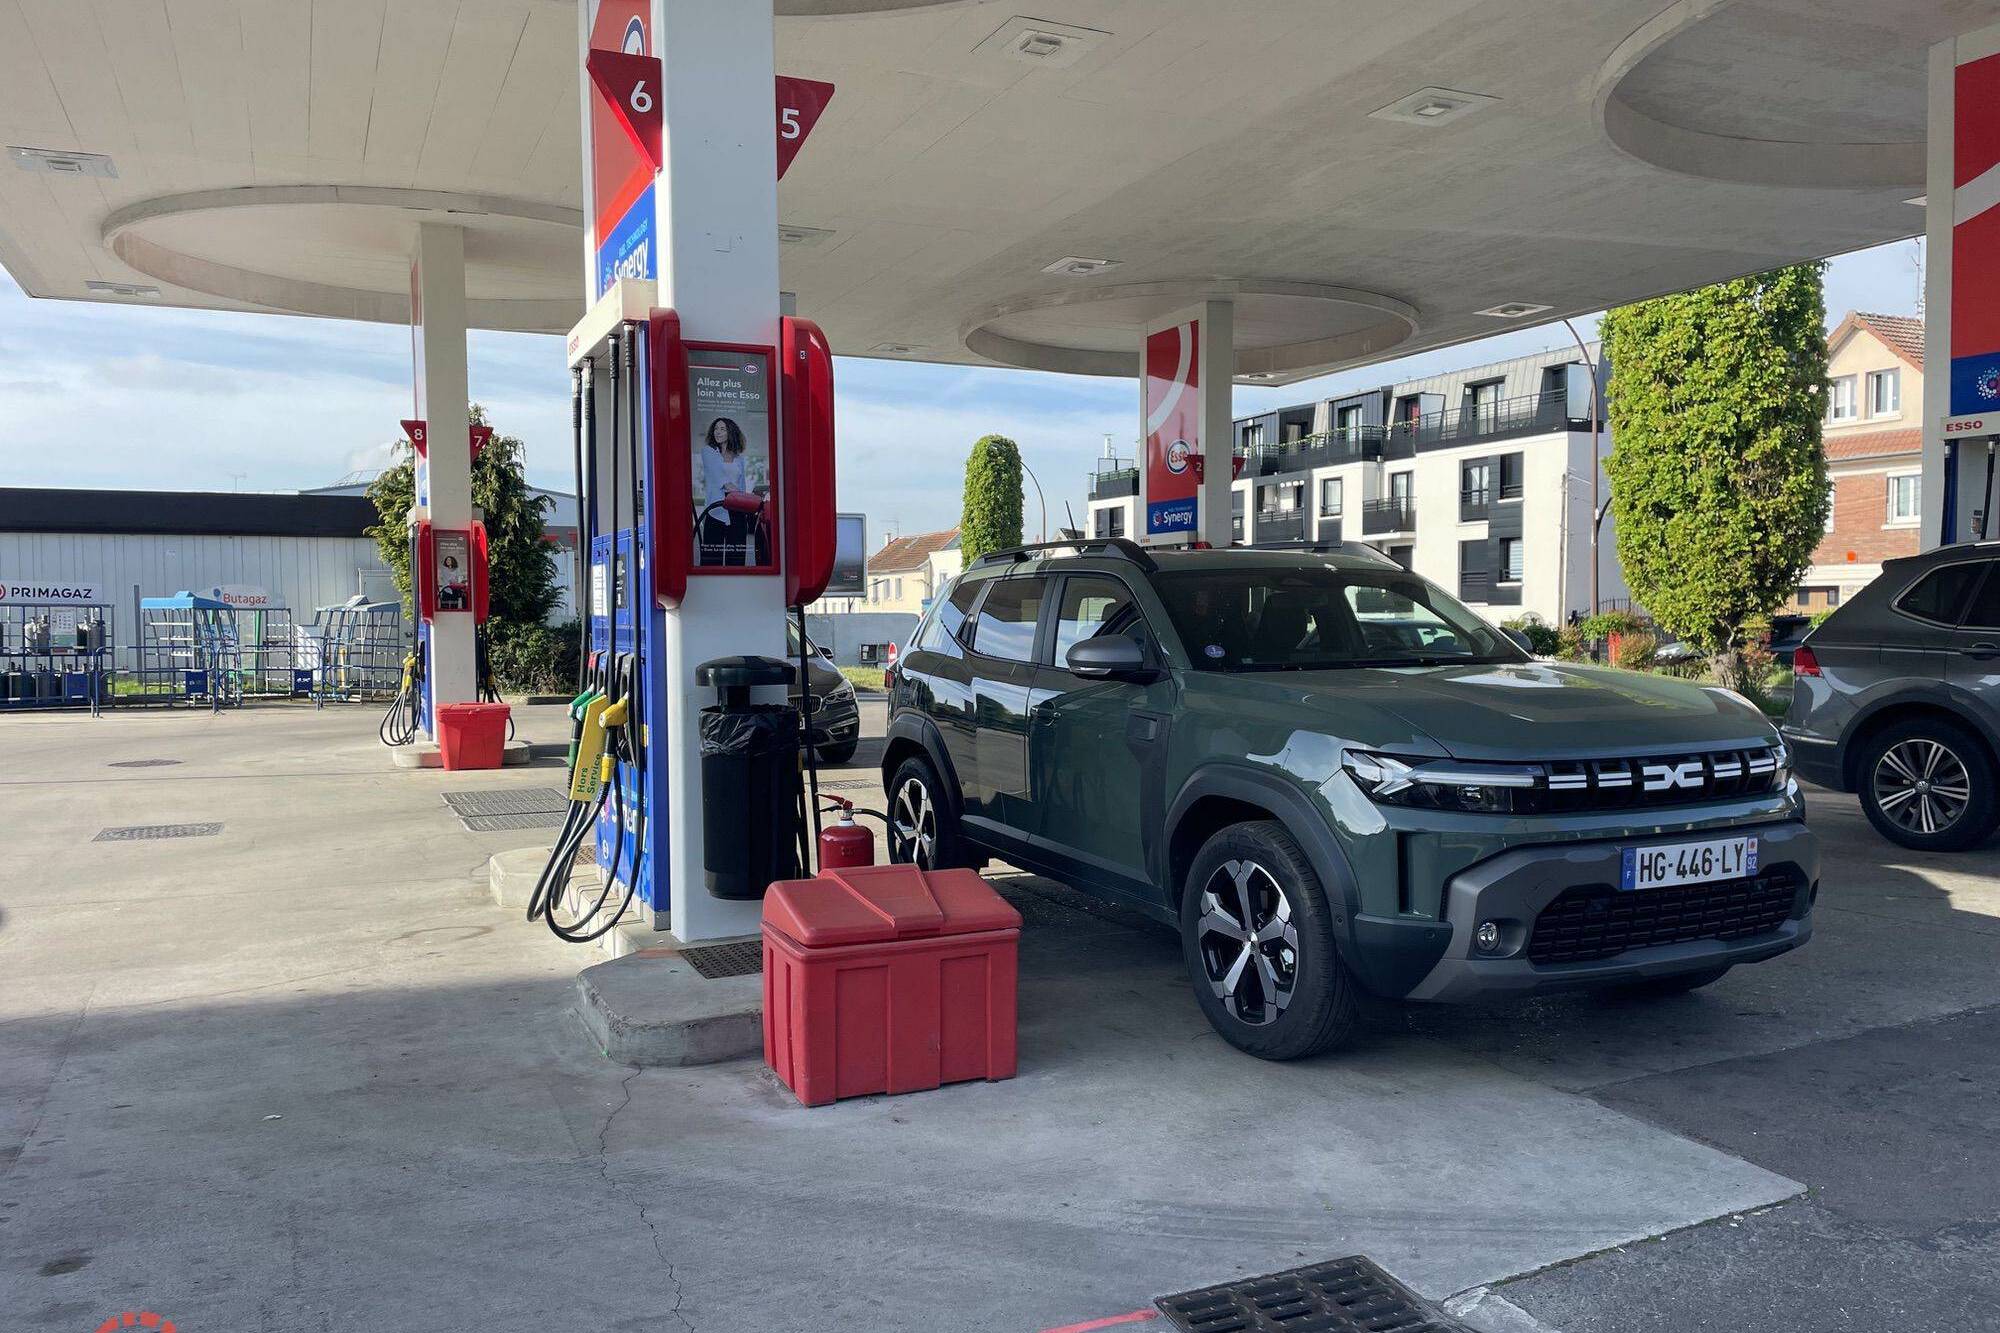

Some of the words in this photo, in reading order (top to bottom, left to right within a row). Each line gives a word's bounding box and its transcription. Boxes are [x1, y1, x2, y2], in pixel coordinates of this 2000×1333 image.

[630, 80, 652, 113] 6
[781, 108, 801, 139] 5
[697, 377, 720, 387] Allez
[722, 379, 742, 389] plus
[697, 387, 715, 397] loin
[717, 390, 738, 399] avec
[740, 390, 760, 400] Esso
[1946, 420, 1983, 432] ESSO
[414, 428, 423, 440] 8
[474, 435, 483, 447] 7
[1196, 462, 1202, 472] 2
[1163, 511, 1192, 527] Synergy
[11, 587, 92, 599] PRIMAGAZ
[223, 593, 268, 606] Butagaz
[576, 767, 588, 793] Hors
[586, 753, 601, 794] Service
[1626, 870, 1632, 880] F
[1640, 843, 1744, 882] HG-446-LY
[1747, 856, 1757, 870] 92
